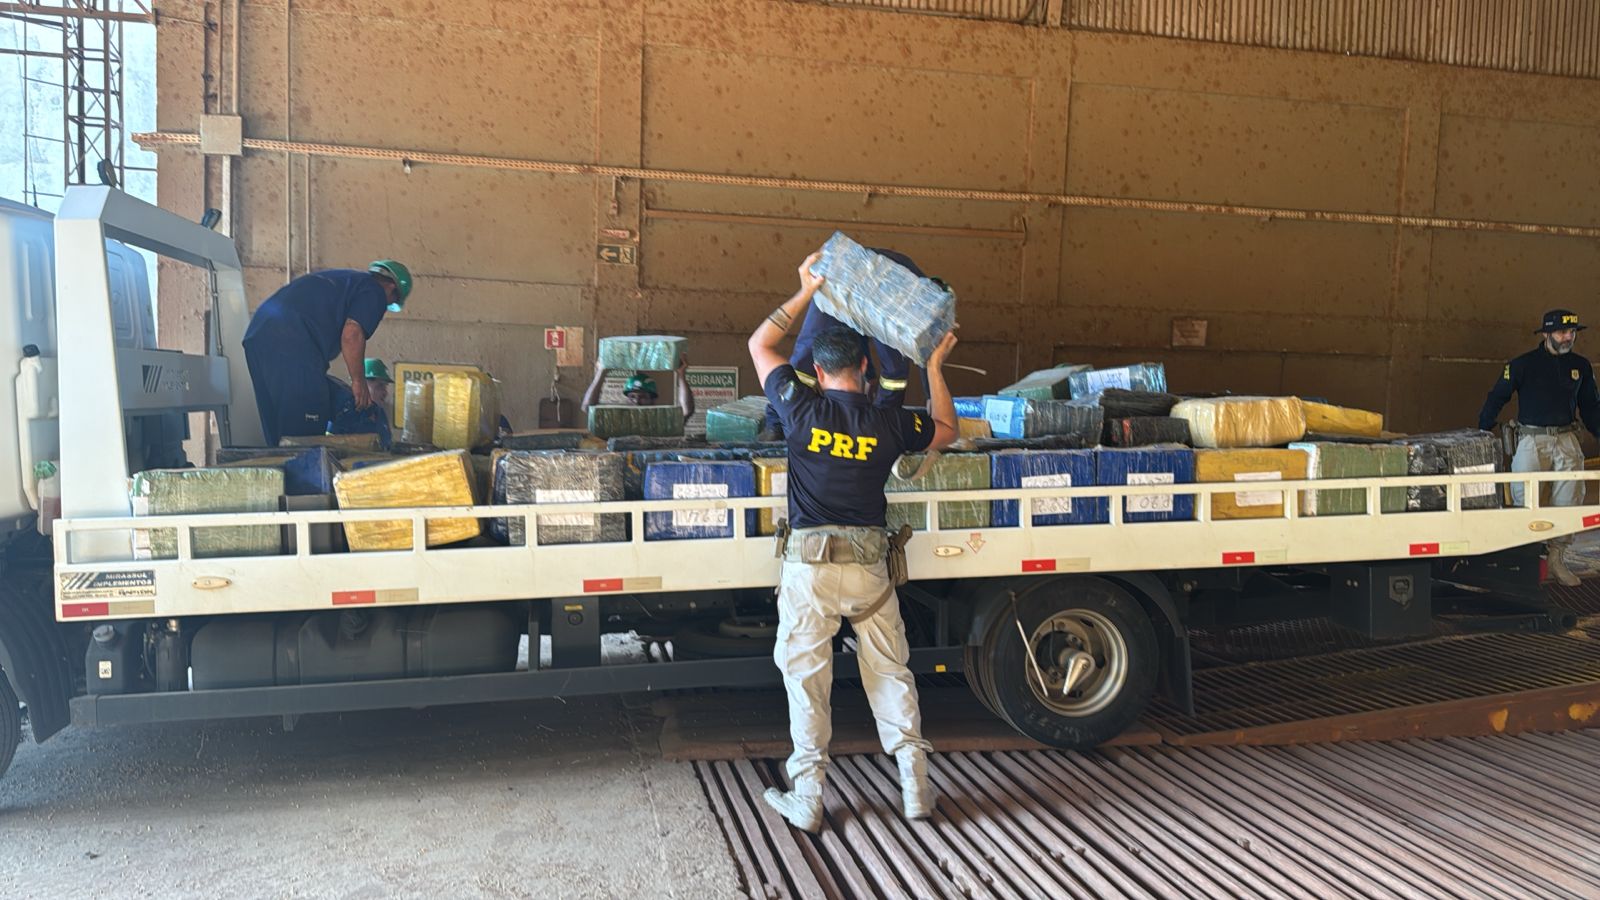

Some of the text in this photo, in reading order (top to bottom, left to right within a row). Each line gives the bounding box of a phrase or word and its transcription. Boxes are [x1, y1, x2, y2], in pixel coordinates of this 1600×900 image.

[1562, 315, 1578, 324] PR
[402, 370, 434, 383] PRO
[685, 374, 734, 387] EGURANÇA
[807, 427, 878, 461] PRF
[105, 572, 147, 580] MIRASSOL
[93, 579, 152, 588] IMPLEMENTOS
